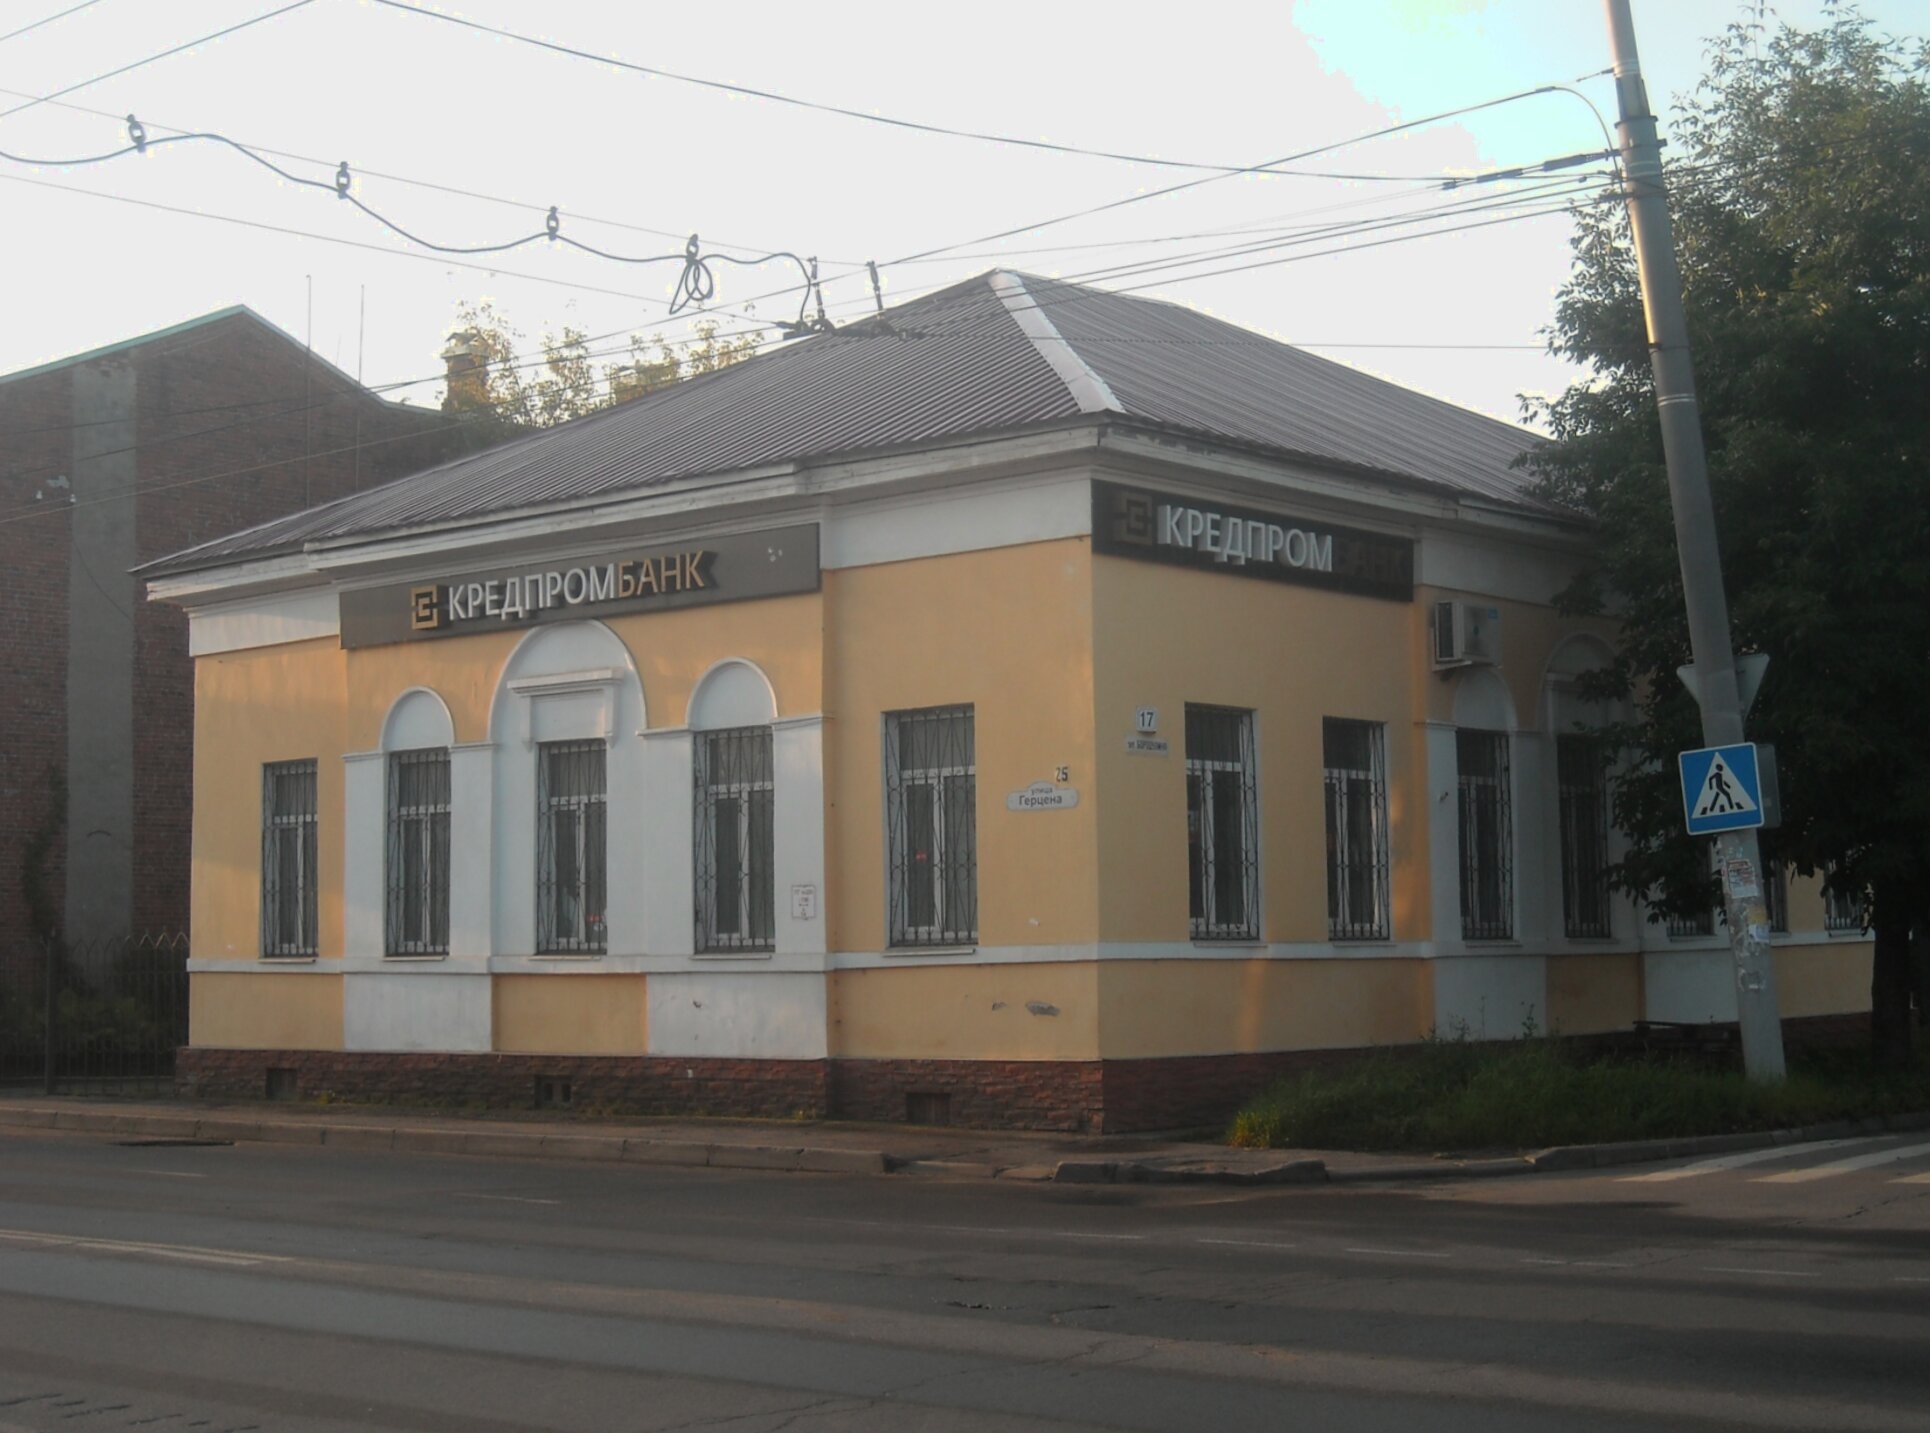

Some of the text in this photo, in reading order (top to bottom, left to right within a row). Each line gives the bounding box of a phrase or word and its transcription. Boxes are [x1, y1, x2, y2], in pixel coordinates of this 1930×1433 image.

[448, 550, 705, 620] КРЕДПРОМБАНК
[1140, 711, 1154, 727] 17
[1056, 766, 1069, 782] 25
[1018, 794, 1063, 808] Герцена
